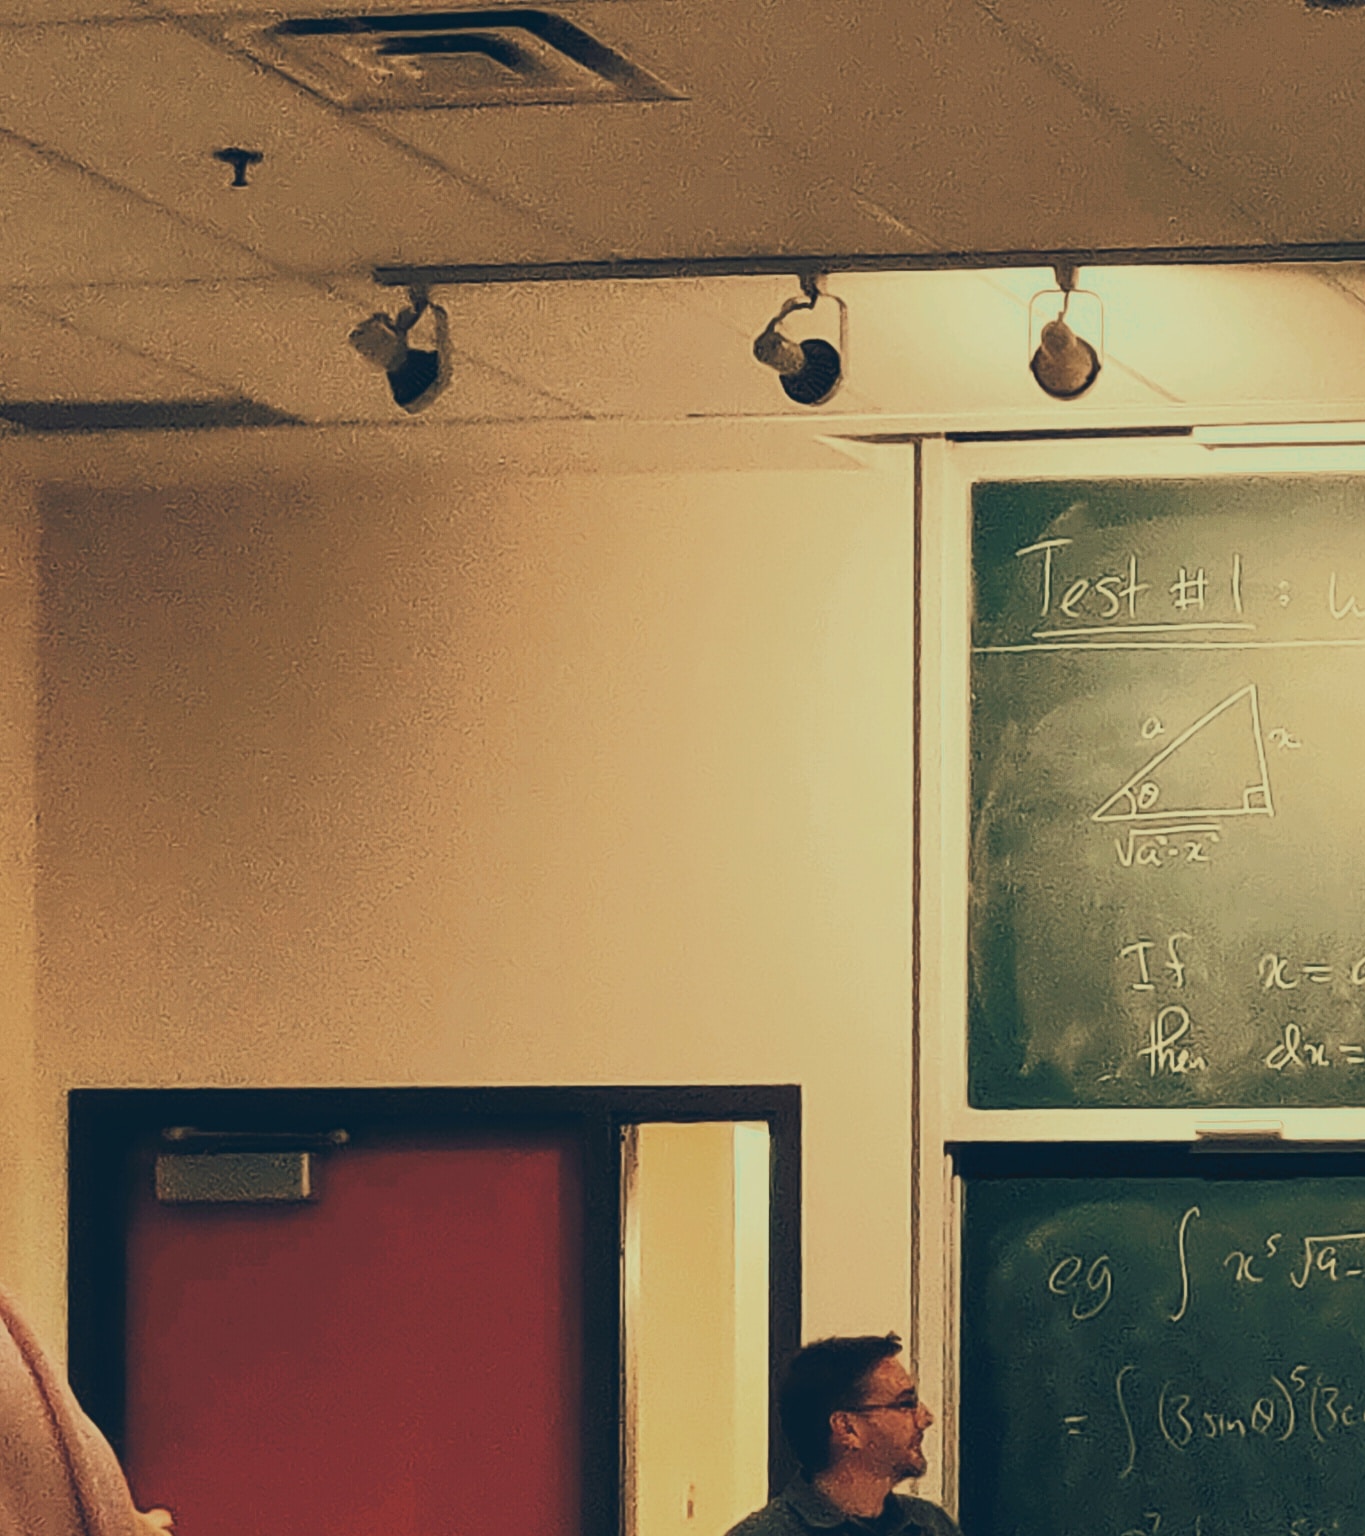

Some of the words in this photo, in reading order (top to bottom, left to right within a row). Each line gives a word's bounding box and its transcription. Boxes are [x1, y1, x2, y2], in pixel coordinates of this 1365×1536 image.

[1015, 537, 1150, 619] Test
[1169, 552, 1244, 615] #1
[1119, 932, 1192, 991] If
